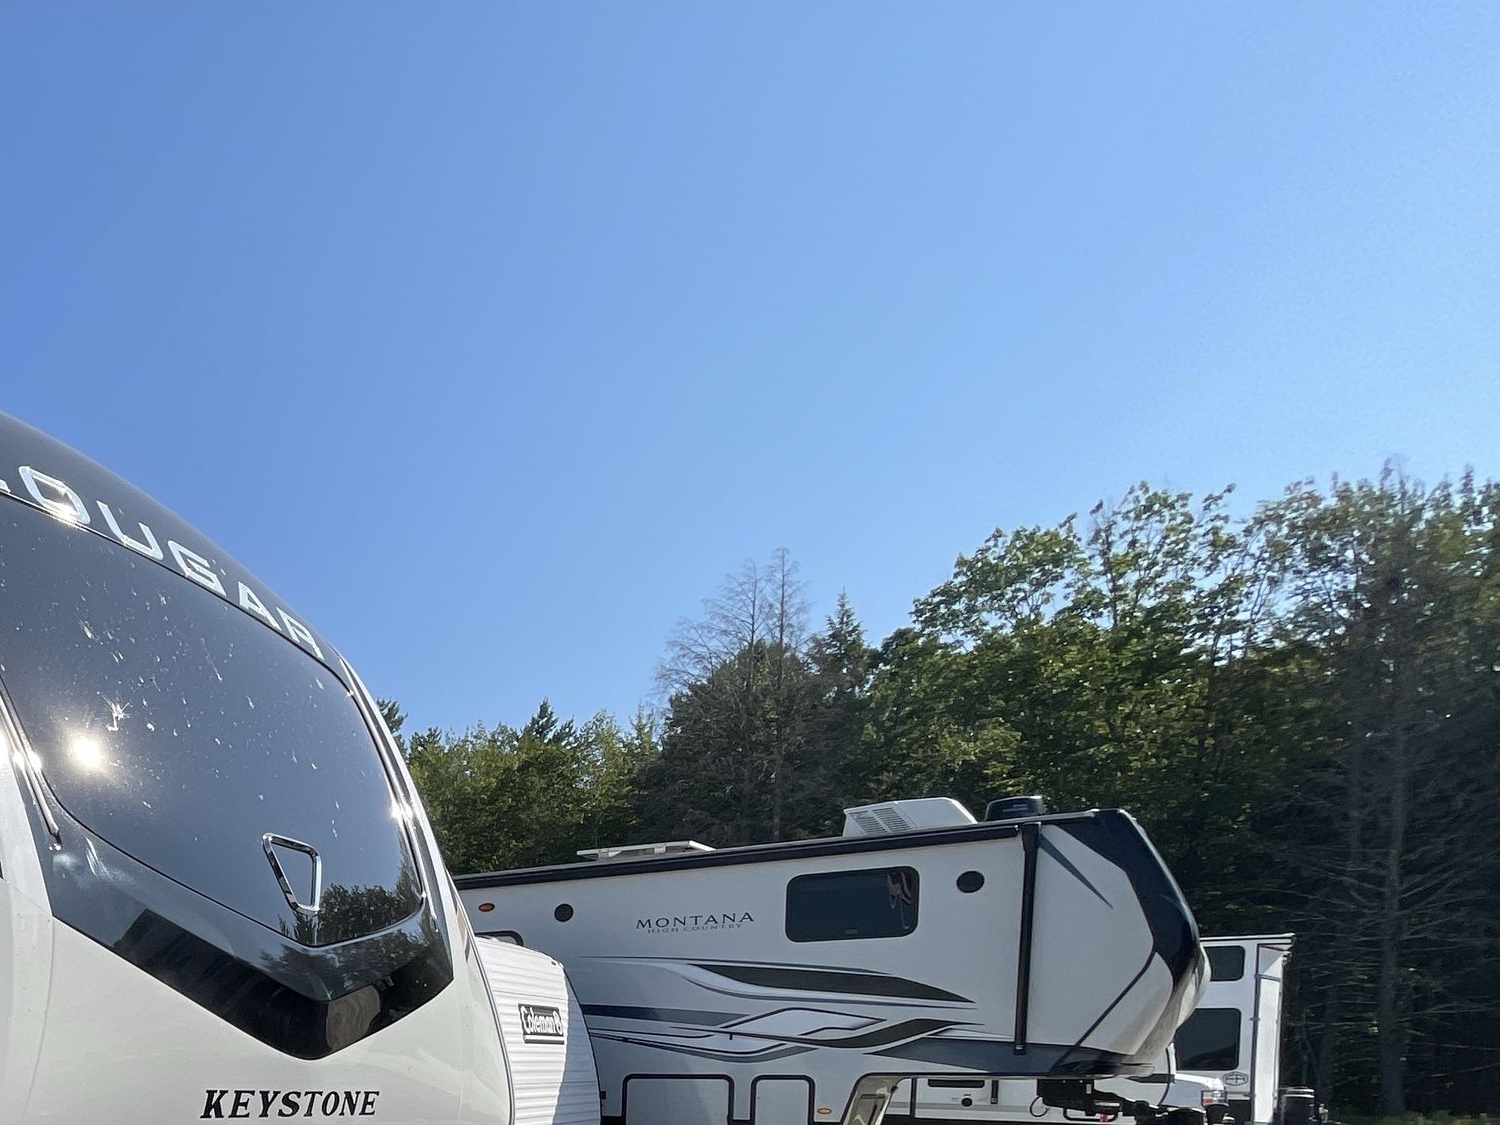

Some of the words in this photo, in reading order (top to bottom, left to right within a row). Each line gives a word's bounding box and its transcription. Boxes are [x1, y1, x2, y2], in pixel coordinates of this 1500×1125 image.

[636, 912, 755, 929] MONTANA
[683, 923, 742, 932] COUNTRY
[521, 1006, 556, 1034] Coleman
[200, 1089, 380, 1119] KEYSTONE
